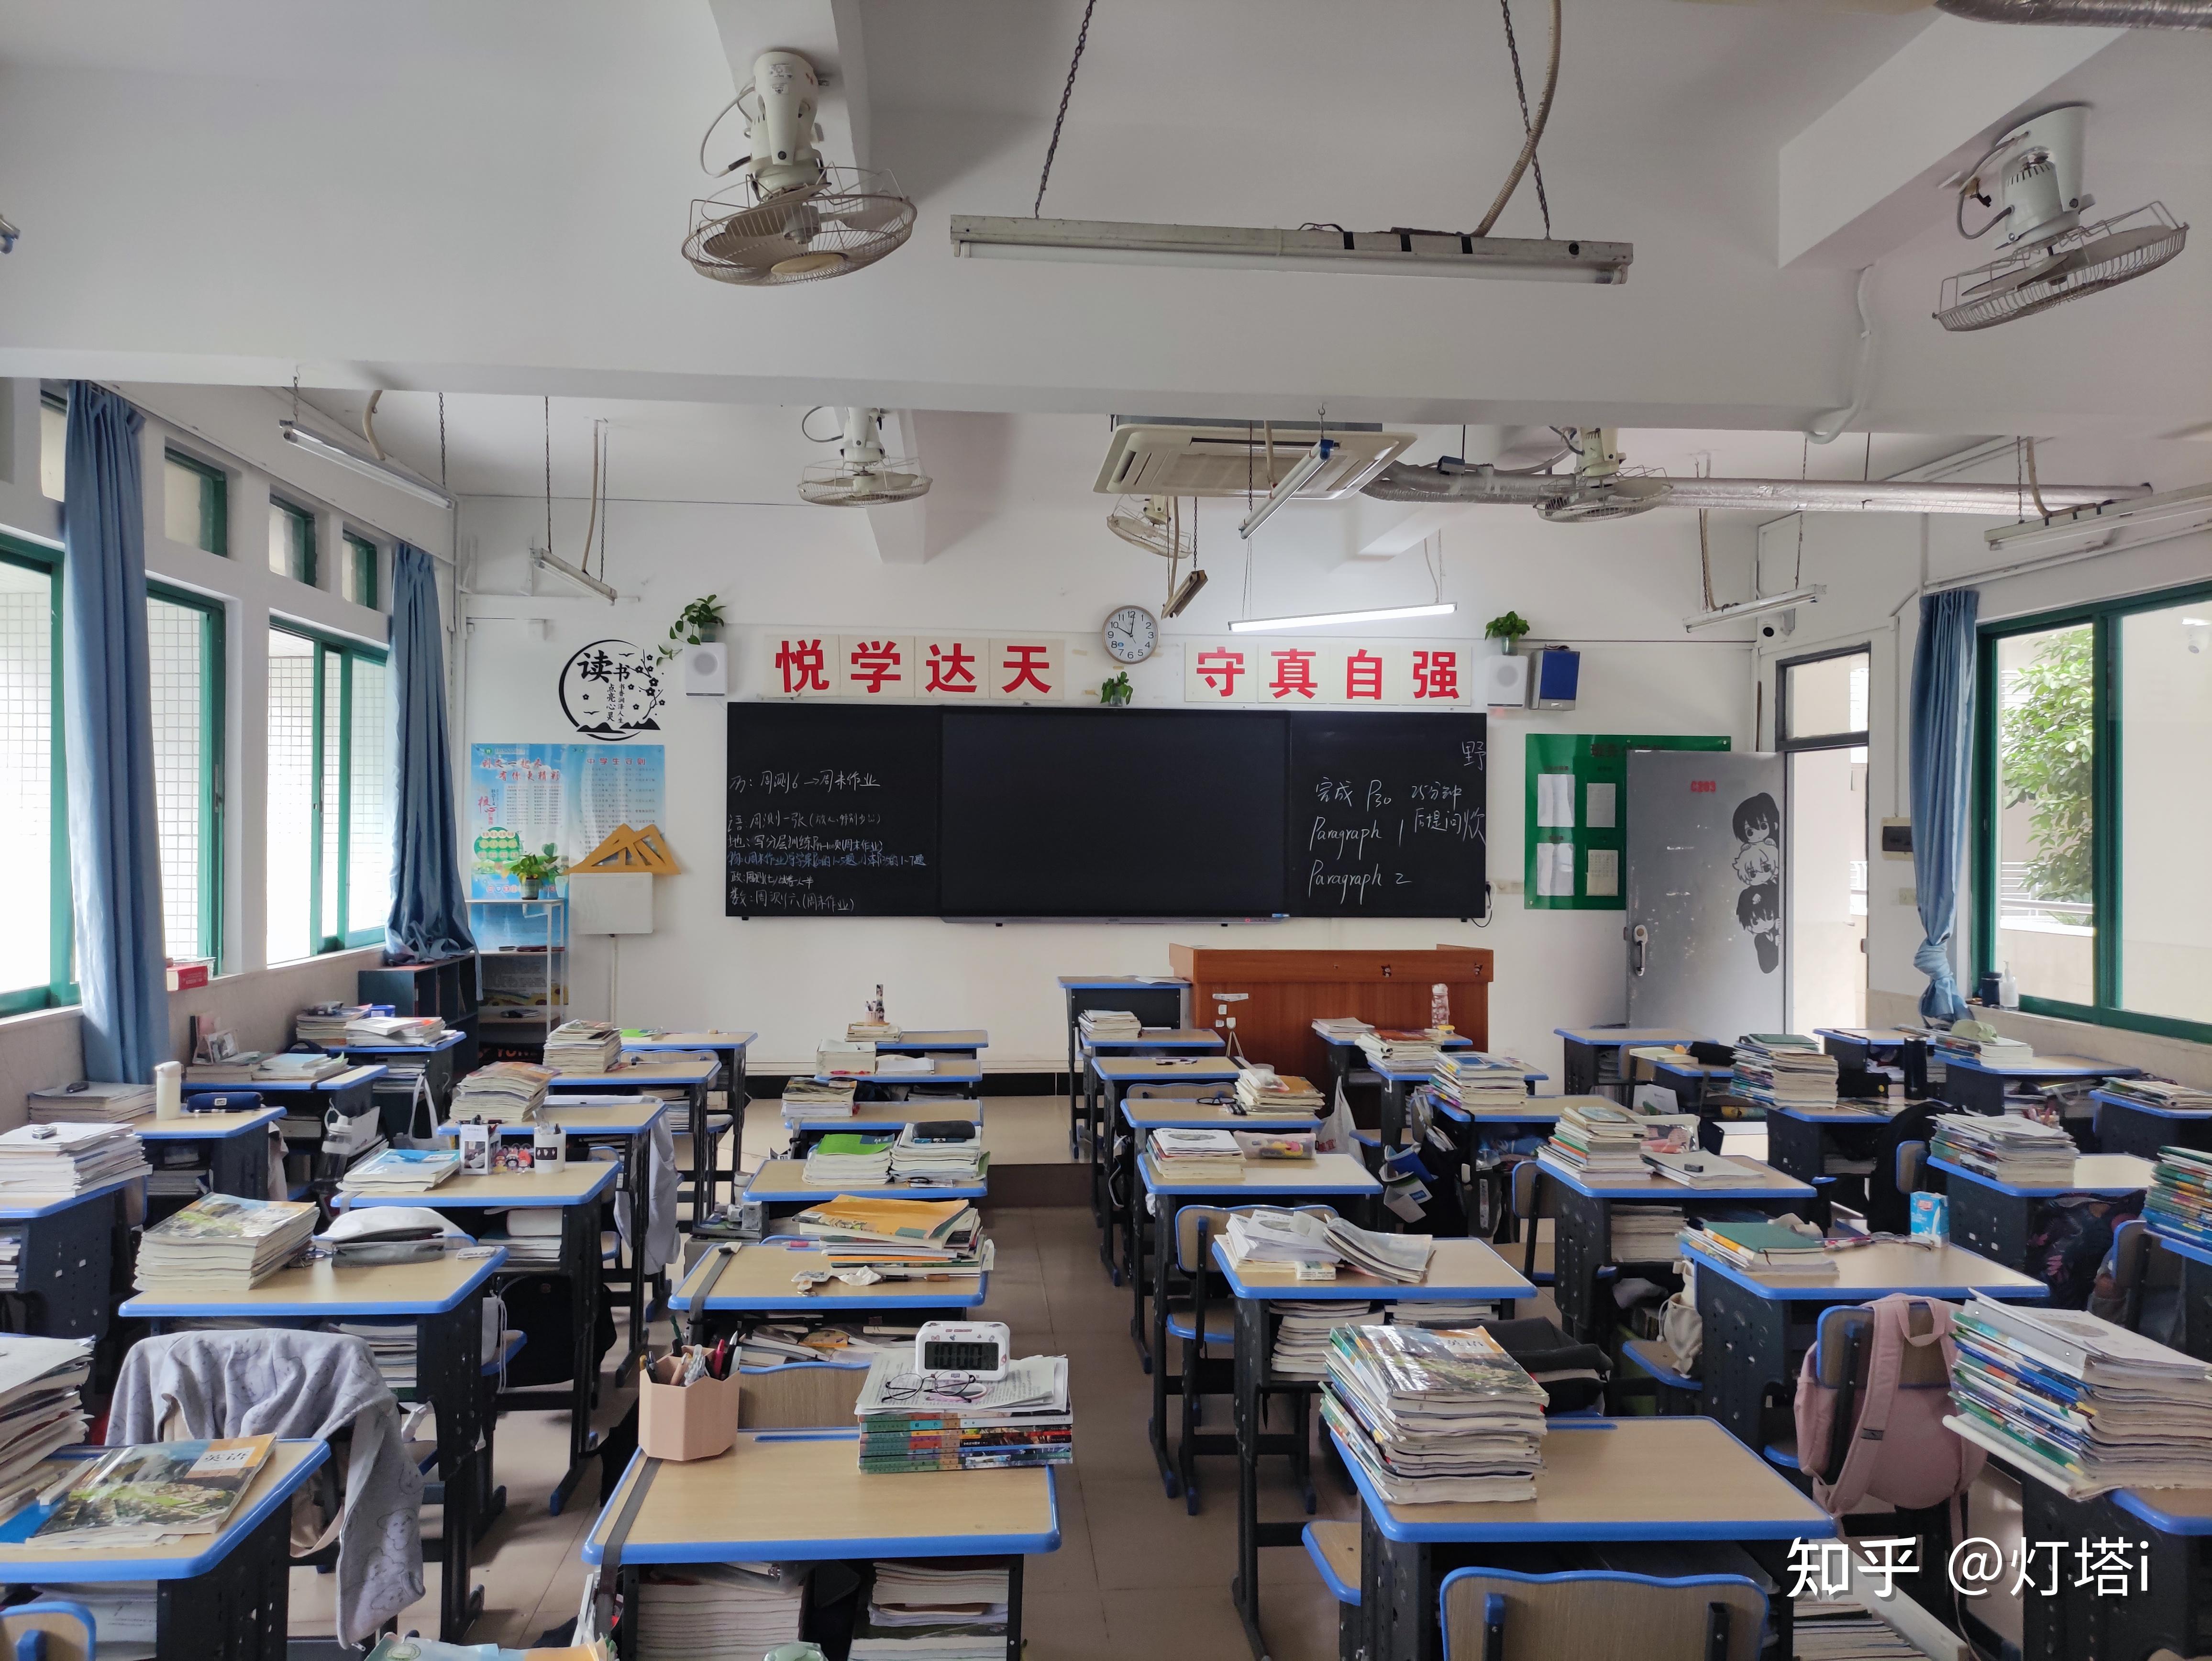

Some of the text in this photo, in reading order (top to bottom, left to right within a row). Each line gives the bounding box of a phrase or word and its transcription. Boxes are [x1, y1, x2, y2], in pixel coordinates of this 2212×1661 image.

[576, 650, 630, 683] 读书
[775, 639, 1052, 694] 悦学达天
[1196, 646, 1460, 700] 守真自强
[606, 683, 616, 722] 点亮心灵
[586, 757, 646, 765] 中学生守则
[1316, 776, 1354, 807] 完成
[1309, 816, 1382, 860] Paragraph
[1308, 859, 1413, 905] Paragraph 2
